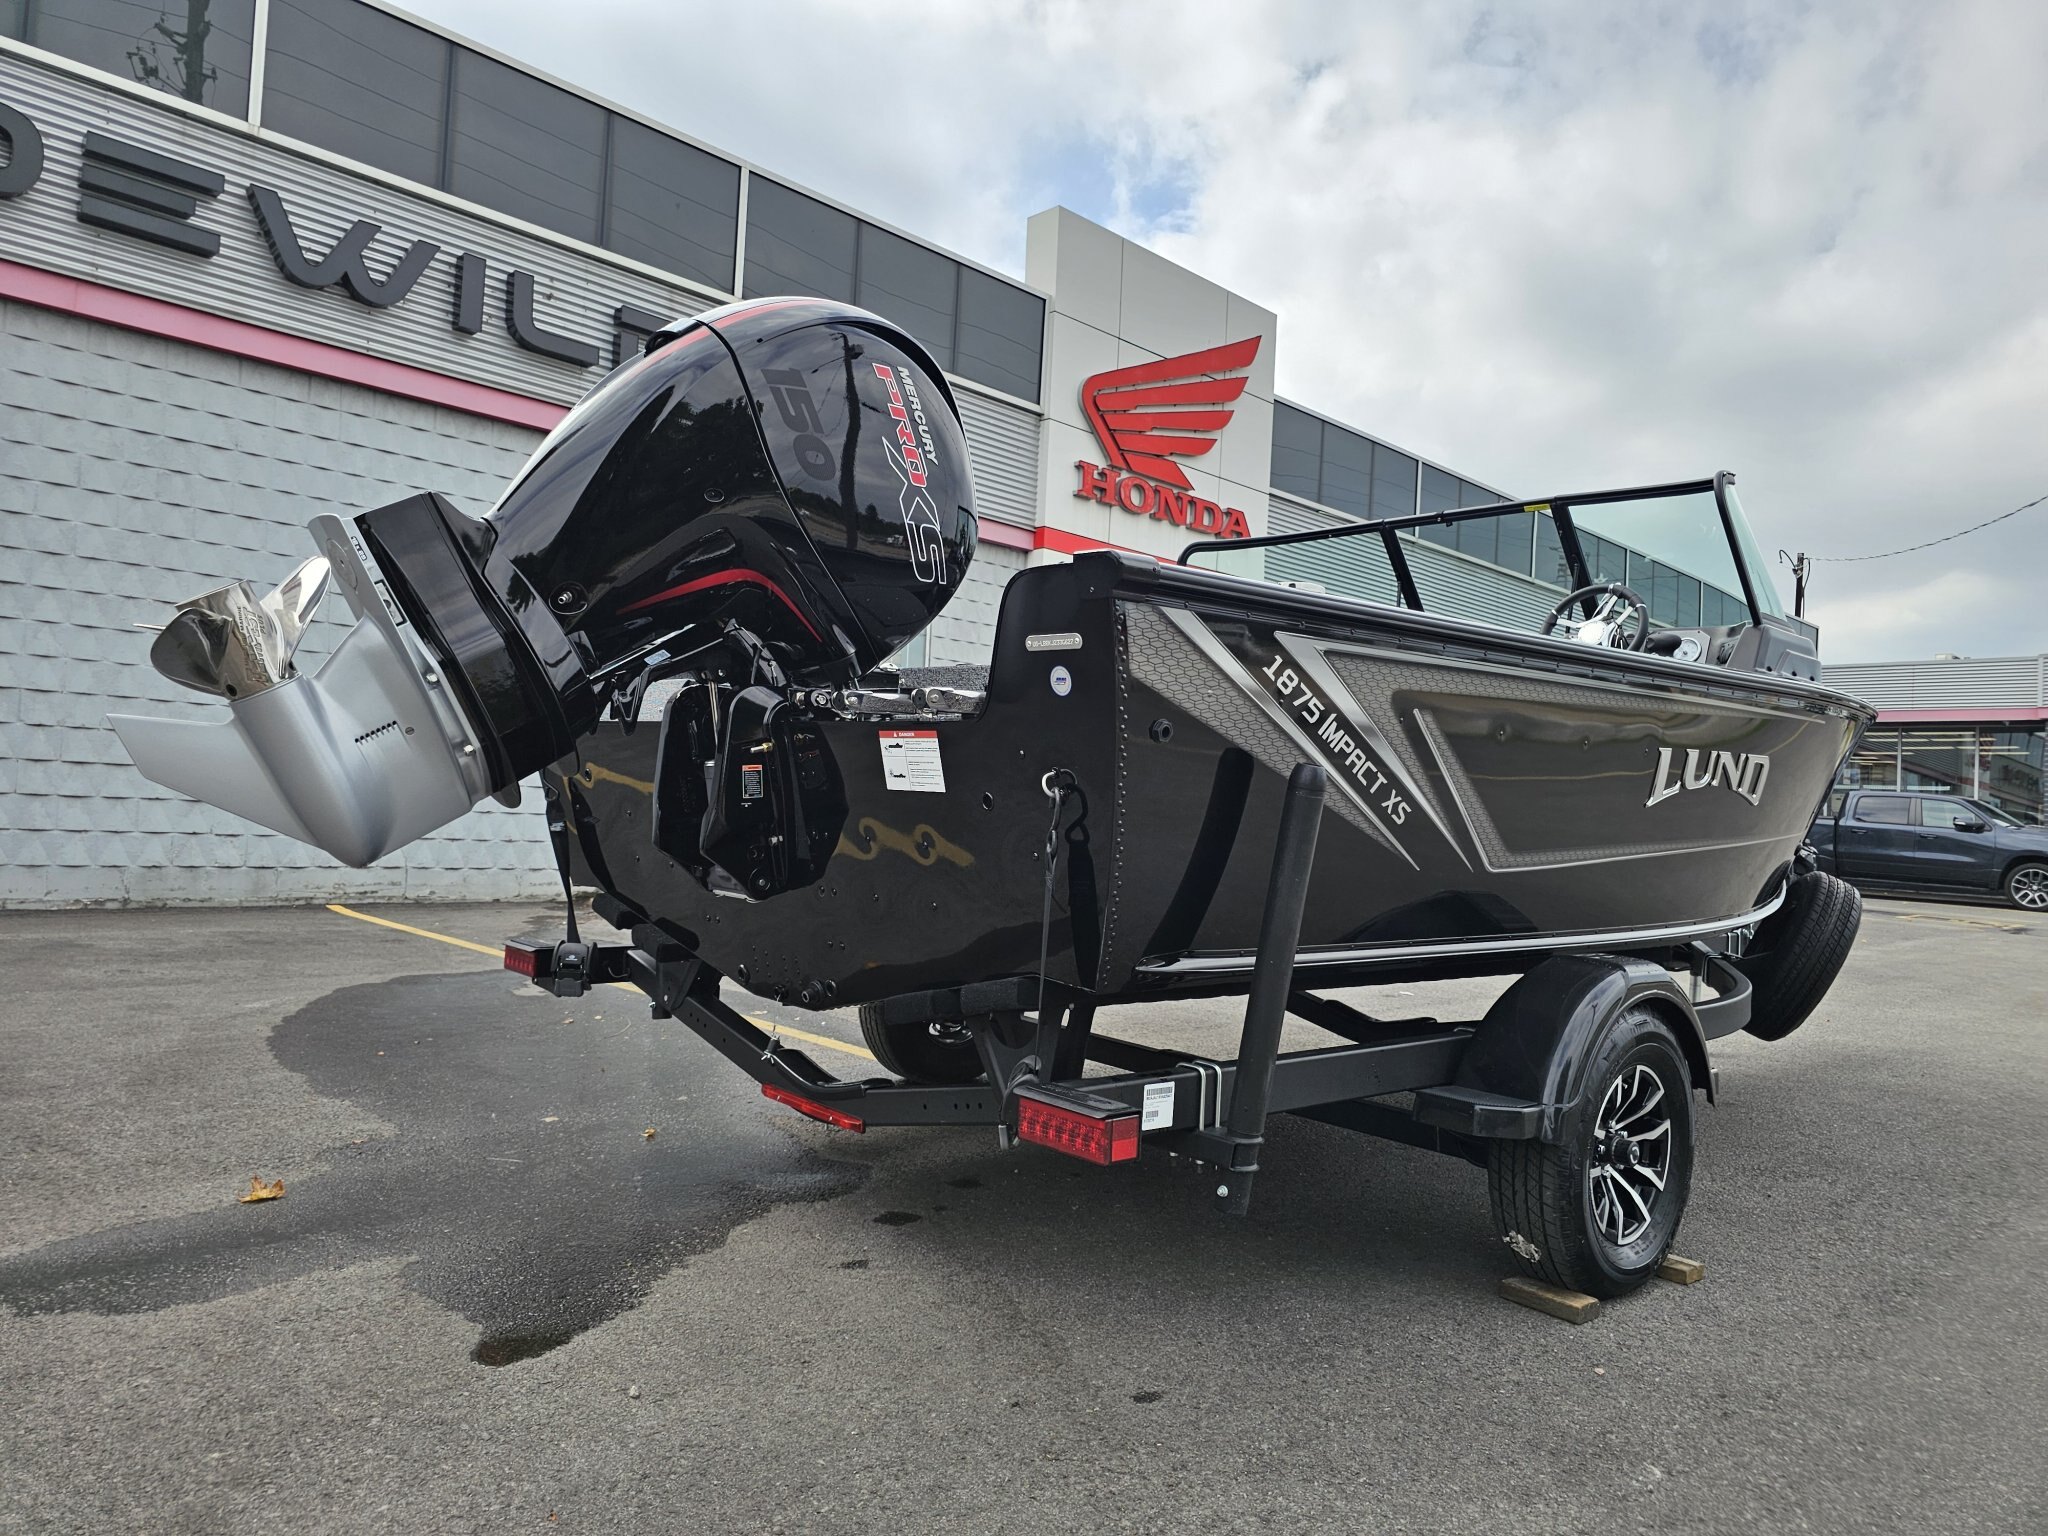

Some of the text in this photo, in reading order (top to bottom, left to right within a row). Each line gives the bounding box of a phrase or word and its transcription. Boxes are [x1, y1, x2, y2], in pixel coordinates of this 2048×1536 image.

[760, 367, 837, 482] 150
[896, 365, 939, 467] MERCURY
[872, 362, 947, 585] PRO XS
[1073, 459, 1252, 539] HONDA
[1261, 654, 1413, 825] 1875 IMPACT XS
[1644, 747, 1771, 808] LUND
